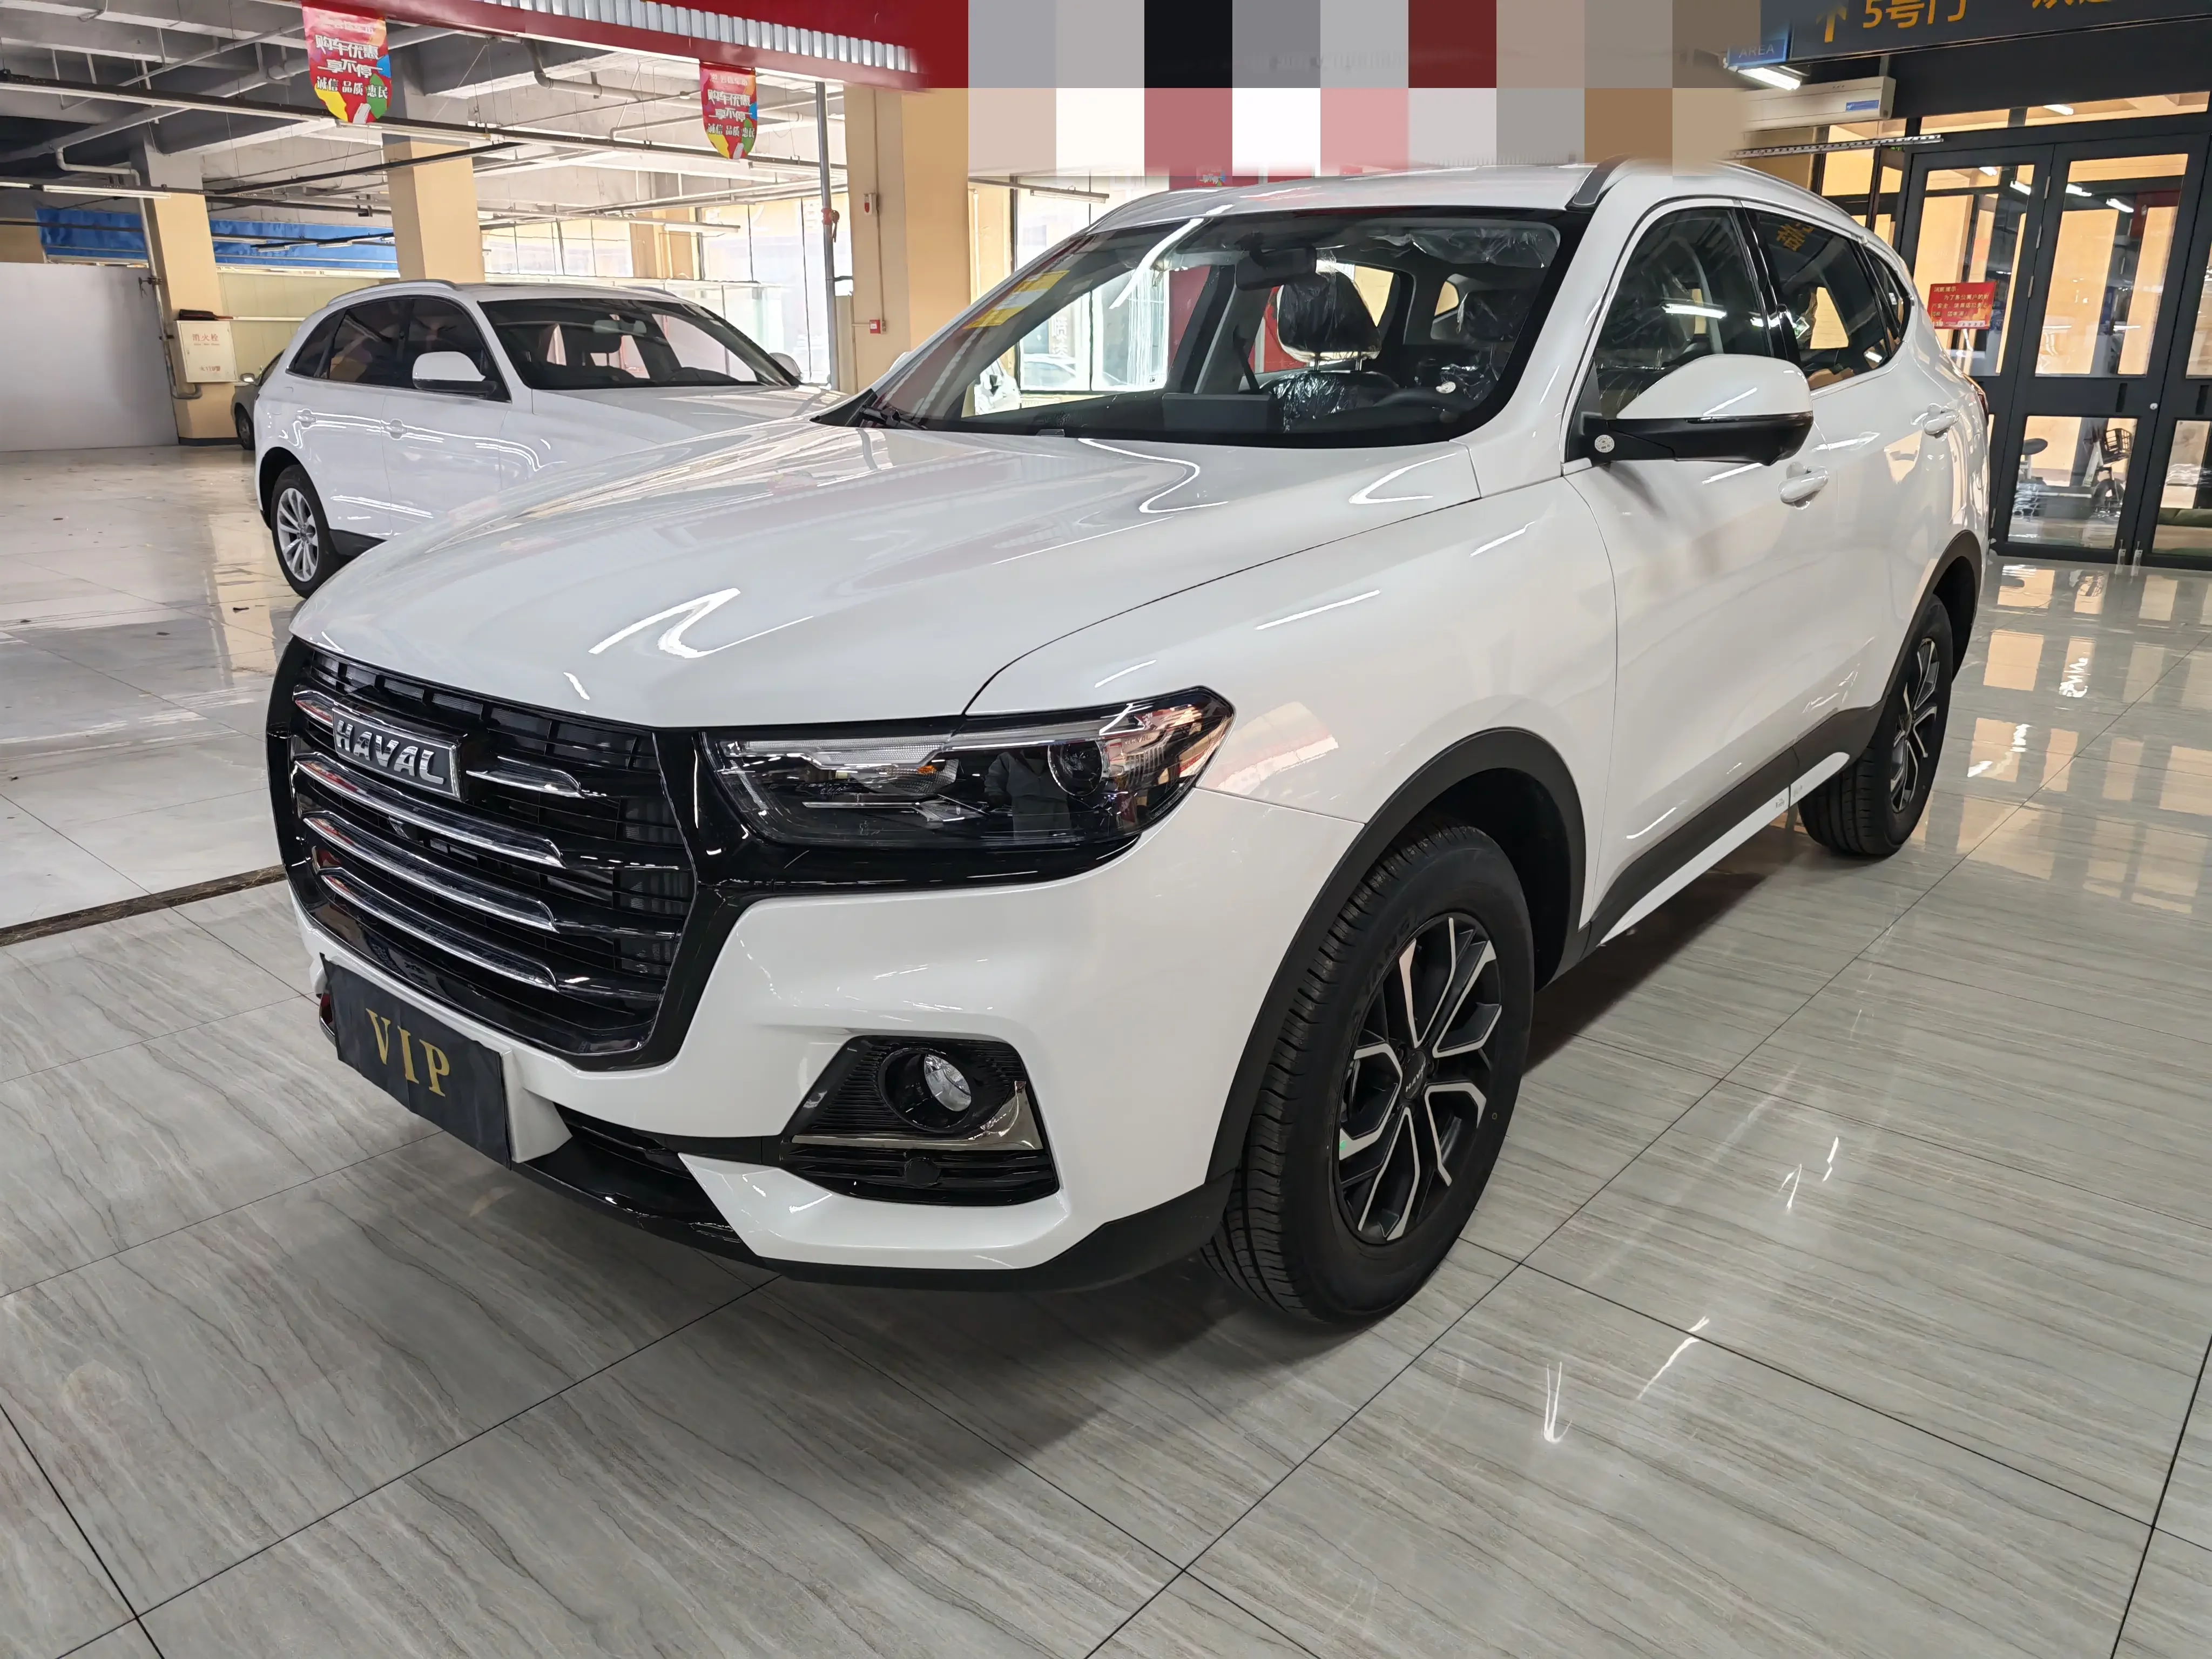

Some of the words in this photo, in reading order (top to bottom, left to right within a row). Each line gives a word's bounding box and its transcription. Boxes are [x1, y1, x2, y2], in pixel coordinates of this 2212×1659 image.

[315, 35, 379, 59] 购车优惠
[1738, 44, 1775, 58] AREA
[327, 58, 372, 78] 享不停
[316, 76, 339, 91] 诚信
[342, 80, 363, 96] 品质
[366, 84, 388, 99] 惠民
[725, 125, 740, 137] 品质
[192, 333, 219, 342] 消火栓
[336, 720, 446, 785] HAVAL
[366, 1008, 450, 1097] VIP
